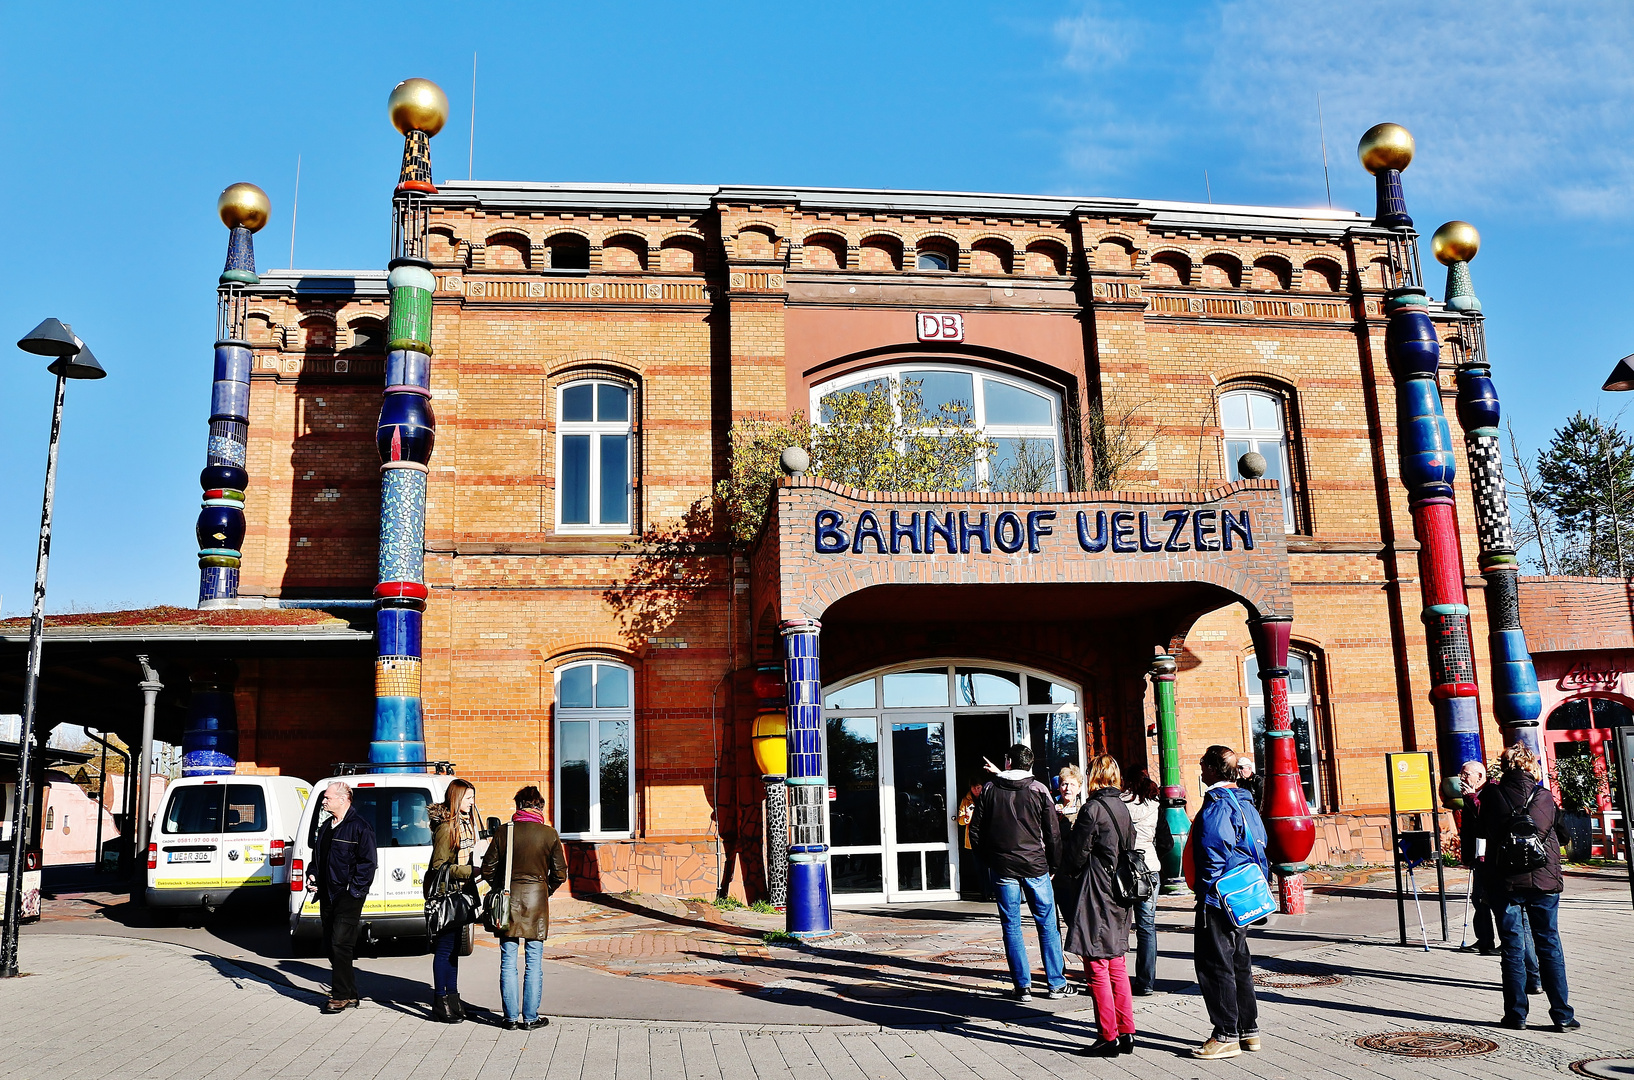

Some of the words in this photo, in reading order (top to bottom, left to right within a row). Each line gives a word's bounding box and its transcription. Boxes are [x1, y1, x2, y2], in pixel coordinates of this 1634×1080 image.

[922, 315, 959, 338] DB
[814, 509, 1057, 555] BAHNHOF
[1075, 509, 1255, 554] UELZEN
[174, 852, 184, 861] UE
[194, 852, 208, 860] 306
[1238, 906, 1263, 921] adidas
